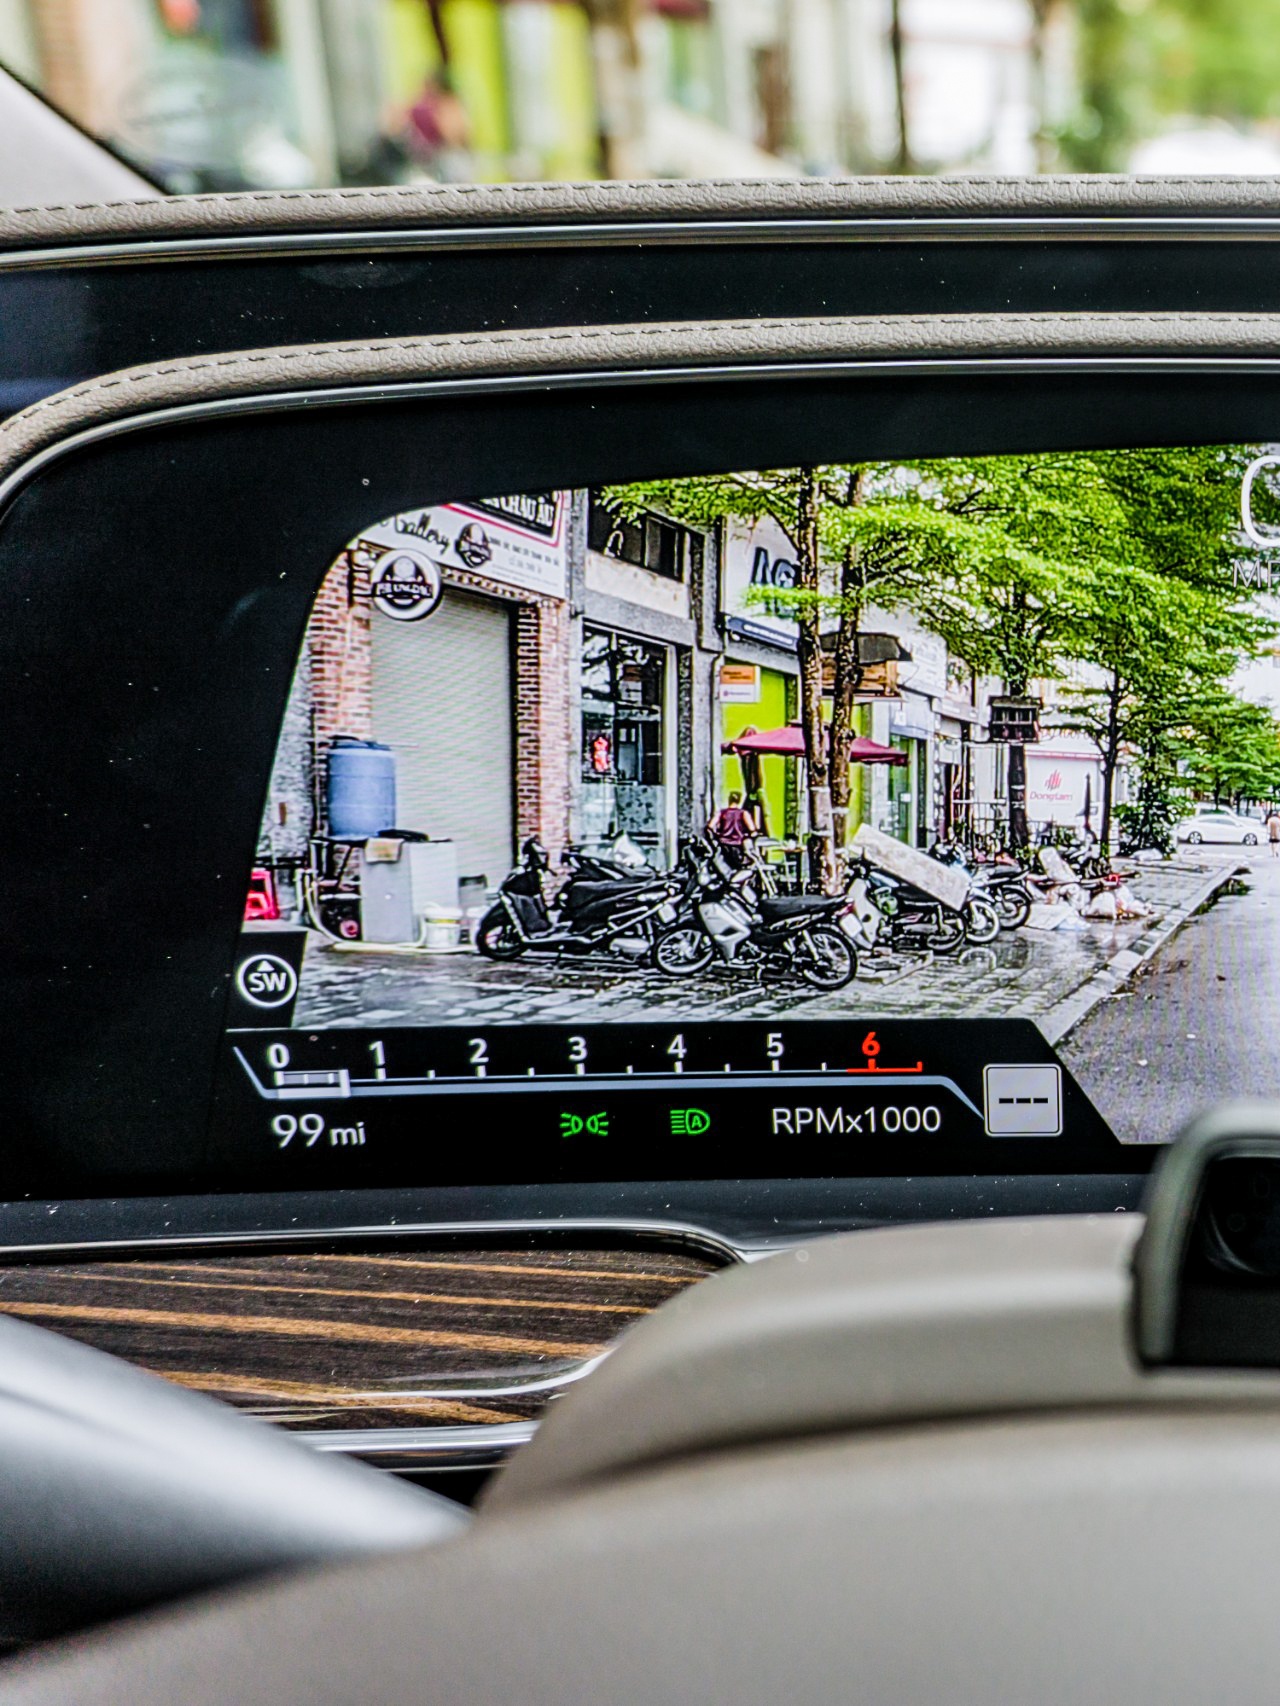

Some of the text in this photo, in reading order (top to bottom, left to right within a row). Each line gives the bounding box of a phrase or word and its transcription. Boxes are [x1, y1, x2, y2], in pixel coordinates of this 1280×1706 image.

[250, 972, 286, 992] SW
[267, 1032, 880, 1068] 0 1 2 3 4 5 6
[272, 1114, 366, 1148] 99 mi
[772, 1106, 941, 1134] RPMx1000
